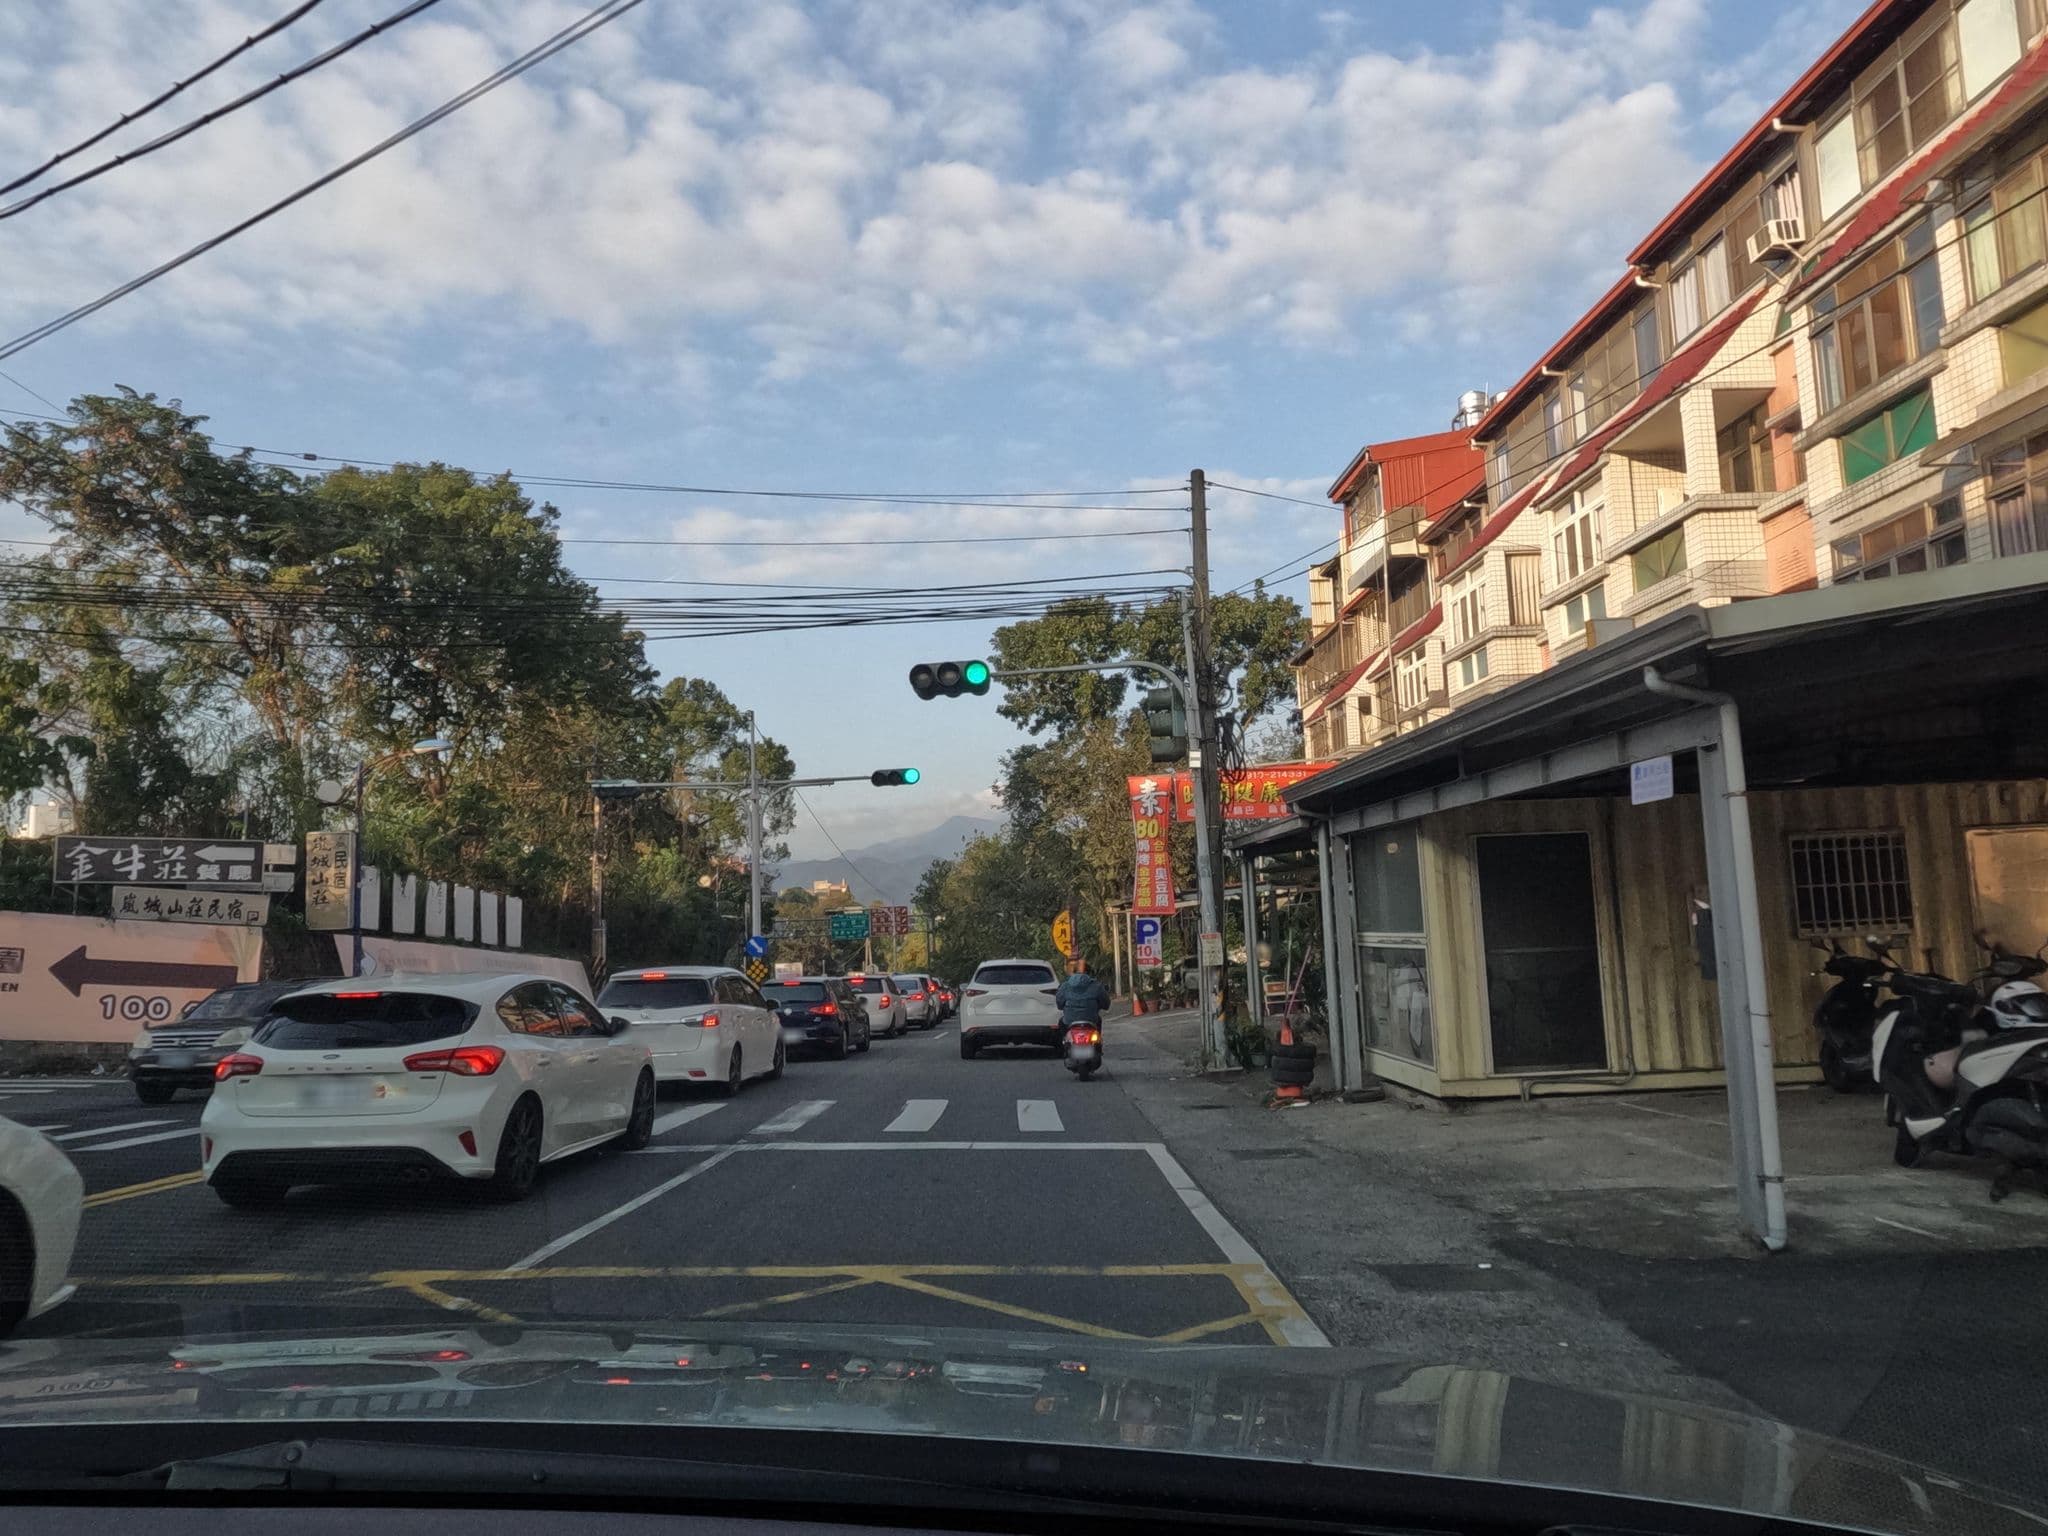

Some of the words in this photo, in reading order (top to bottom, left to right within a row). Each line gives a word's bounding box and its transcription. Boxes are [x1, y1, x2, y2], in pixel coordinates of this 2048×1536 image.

[1132, 779, 1168, 817] 素
[1136, 819, 1159, 839] 80
[65, 842, 189, 881] 金牛莊
[196, 864, 252, 881] 餐廳
[1136, 919, 1159, 944] P
[1136, 945, 1152, 957] 10
[0, 982, 19, 993] EN
[99, 994, 172, 1022] 100
